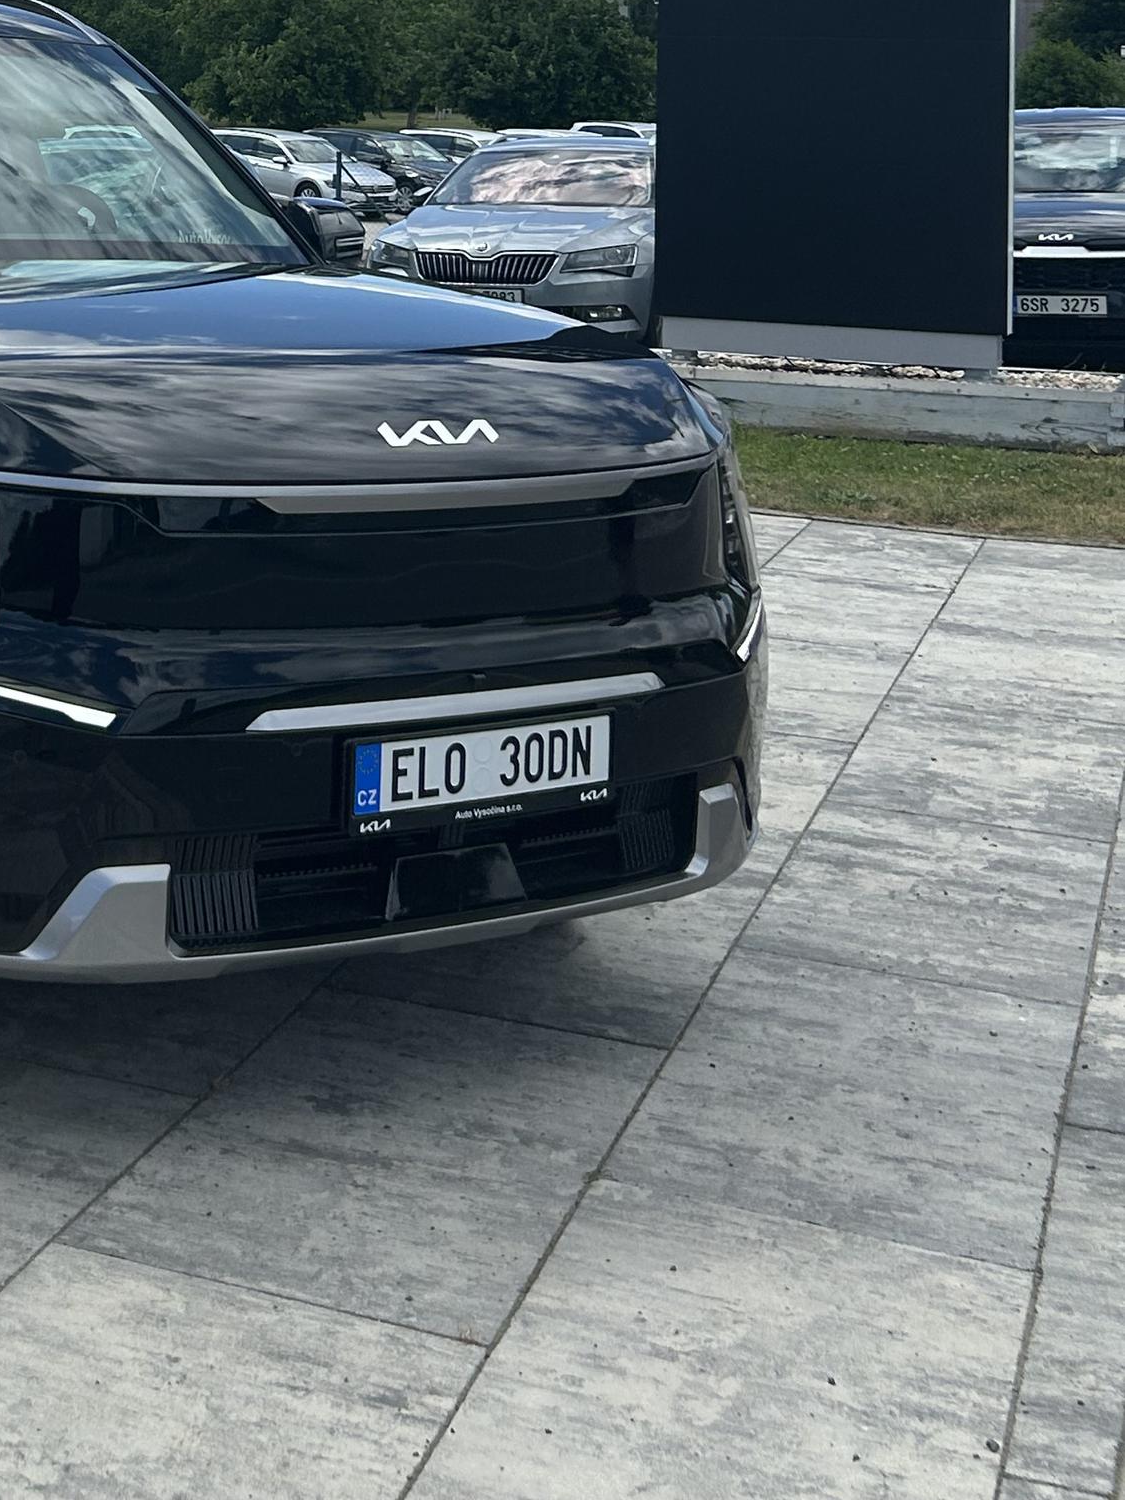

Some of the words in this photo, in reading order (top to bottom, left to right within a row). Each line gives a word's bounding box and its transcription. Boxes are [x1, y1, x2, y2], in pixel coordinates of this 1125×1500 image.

[1020, 297, 1049, 313] 6SR
[1060, 297, 1100, 313] 3275
[377, 418, 500, 448] KIA
[357, 788, 377, 807] CZ
[580, 787, 608, 802] KIA
[454, 809, 473, 820] Auto
[359, 818, 392, 834] KIA
